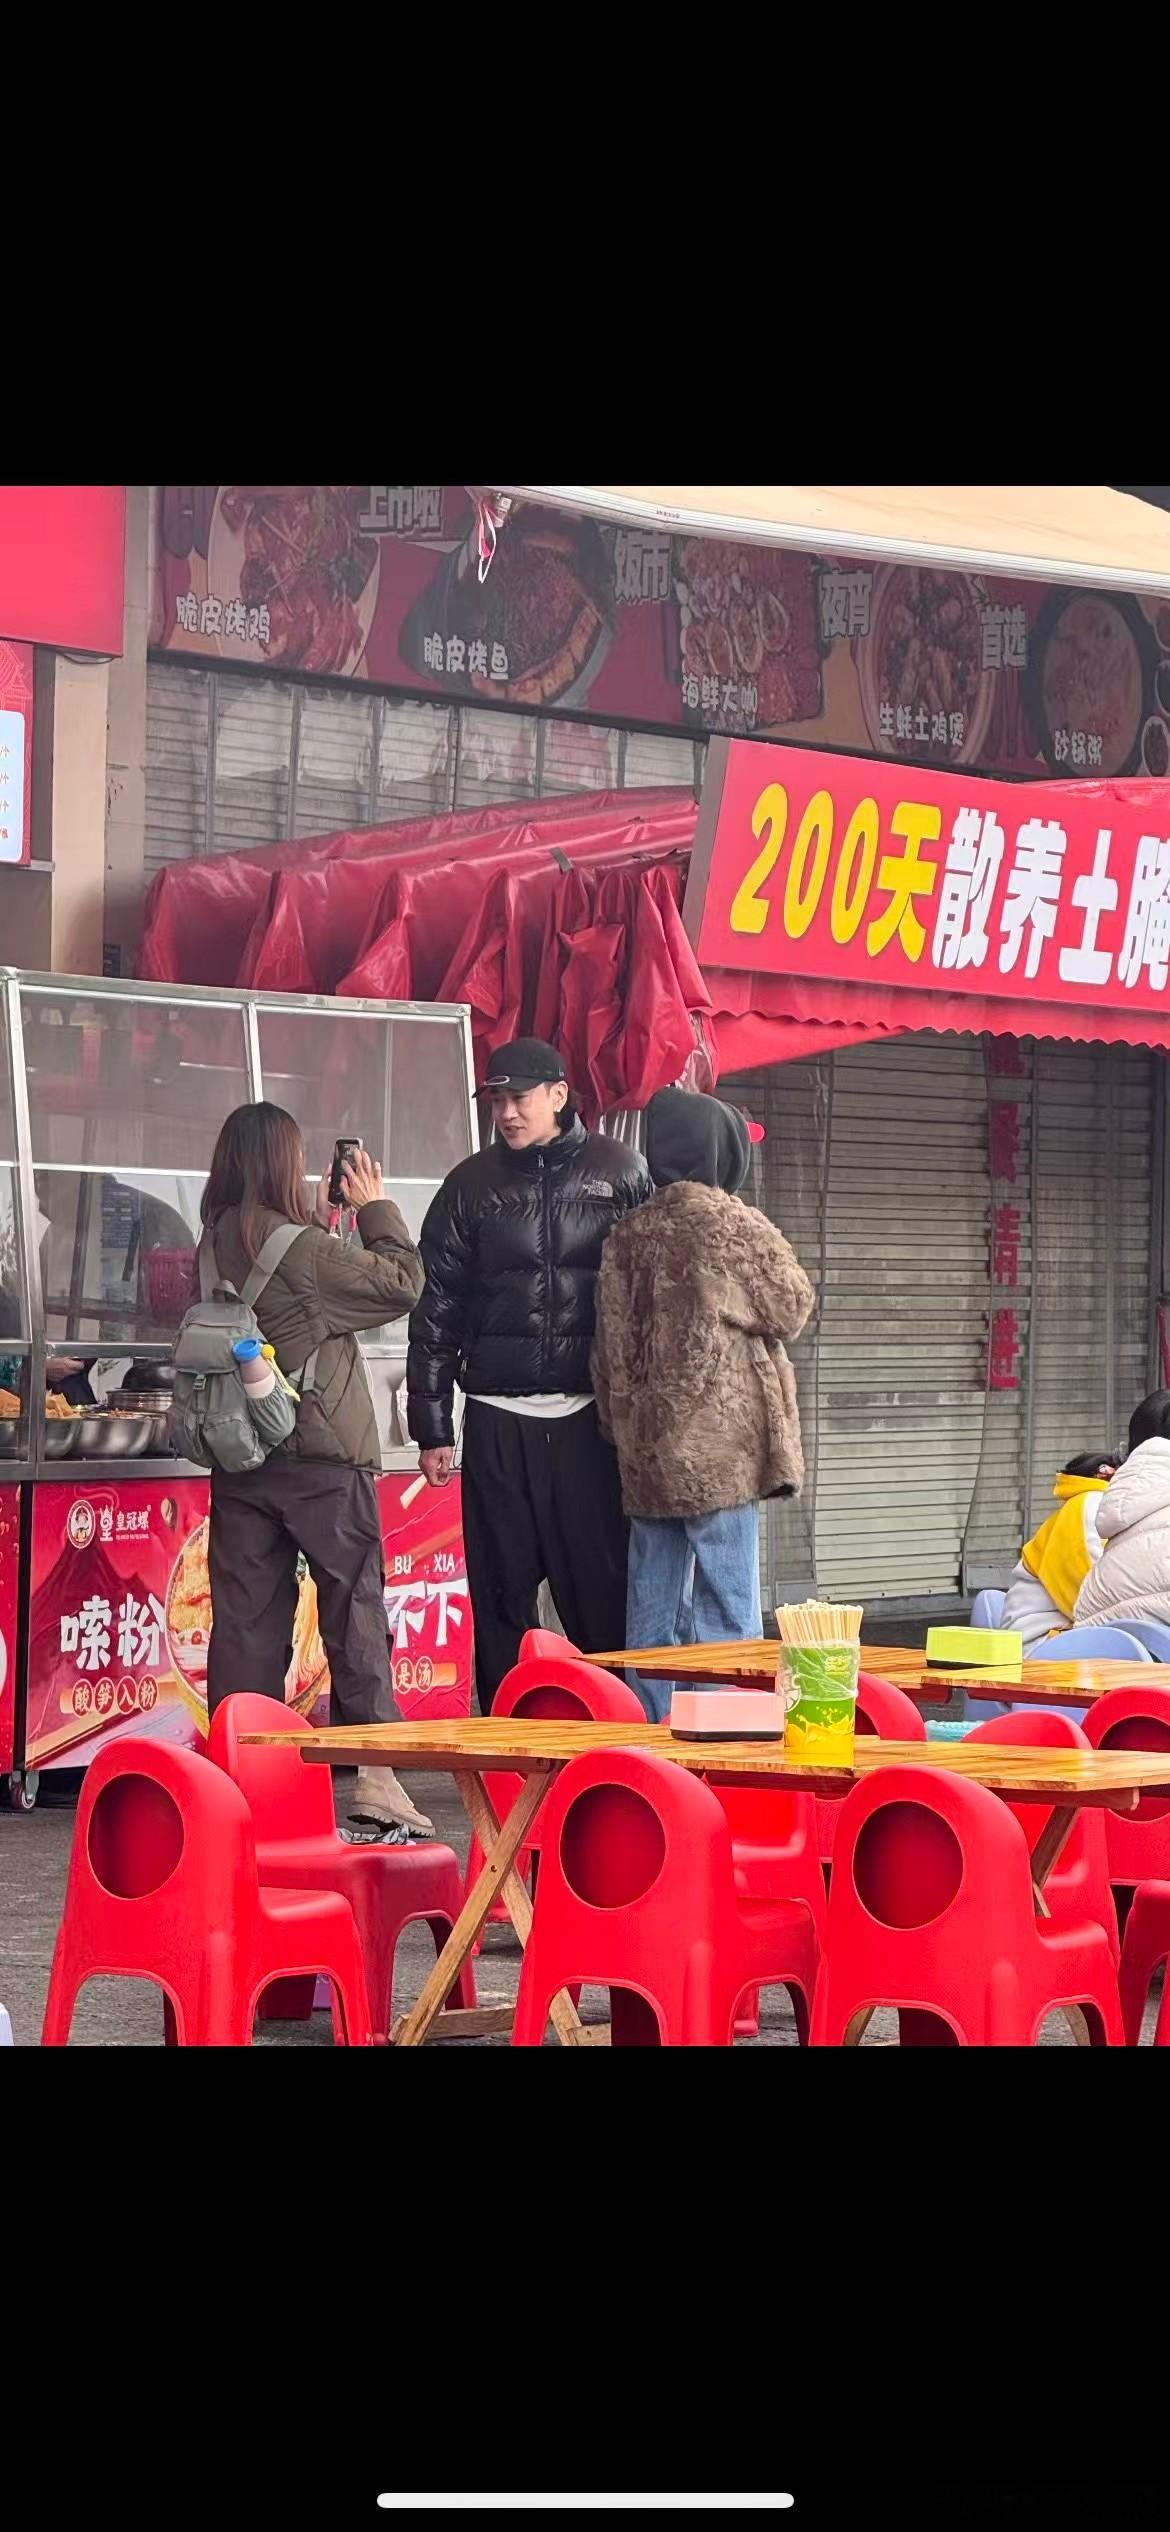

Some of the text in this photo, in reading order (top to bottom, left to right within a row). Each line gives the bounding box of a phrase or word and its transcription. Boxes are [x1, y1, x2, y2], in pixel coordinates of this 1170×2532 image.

[176, 592, 270, 643] 脆皮烤鸡
[823, 569, 872, 637] 夜宵
[424, 632, 508, 680] 脆皮烤鱼
[980, 604, 1025, 669] 首选
[682, 673, 758, 713] 海鲜大咖
[879, 702, 964, 746] 生蚝土鸡煲
[1055, 730, 1102, 766] 砂锅粥
[395, 1553, 455, 1574] BU XIA
[60, 1593, 166, 1670] 嗦粉
[384, 1578, 467, 1648] 不下
[73, 1680, 158, 1715] 酸笋入粉
[398, 1662, 431, 1688] 是汤
